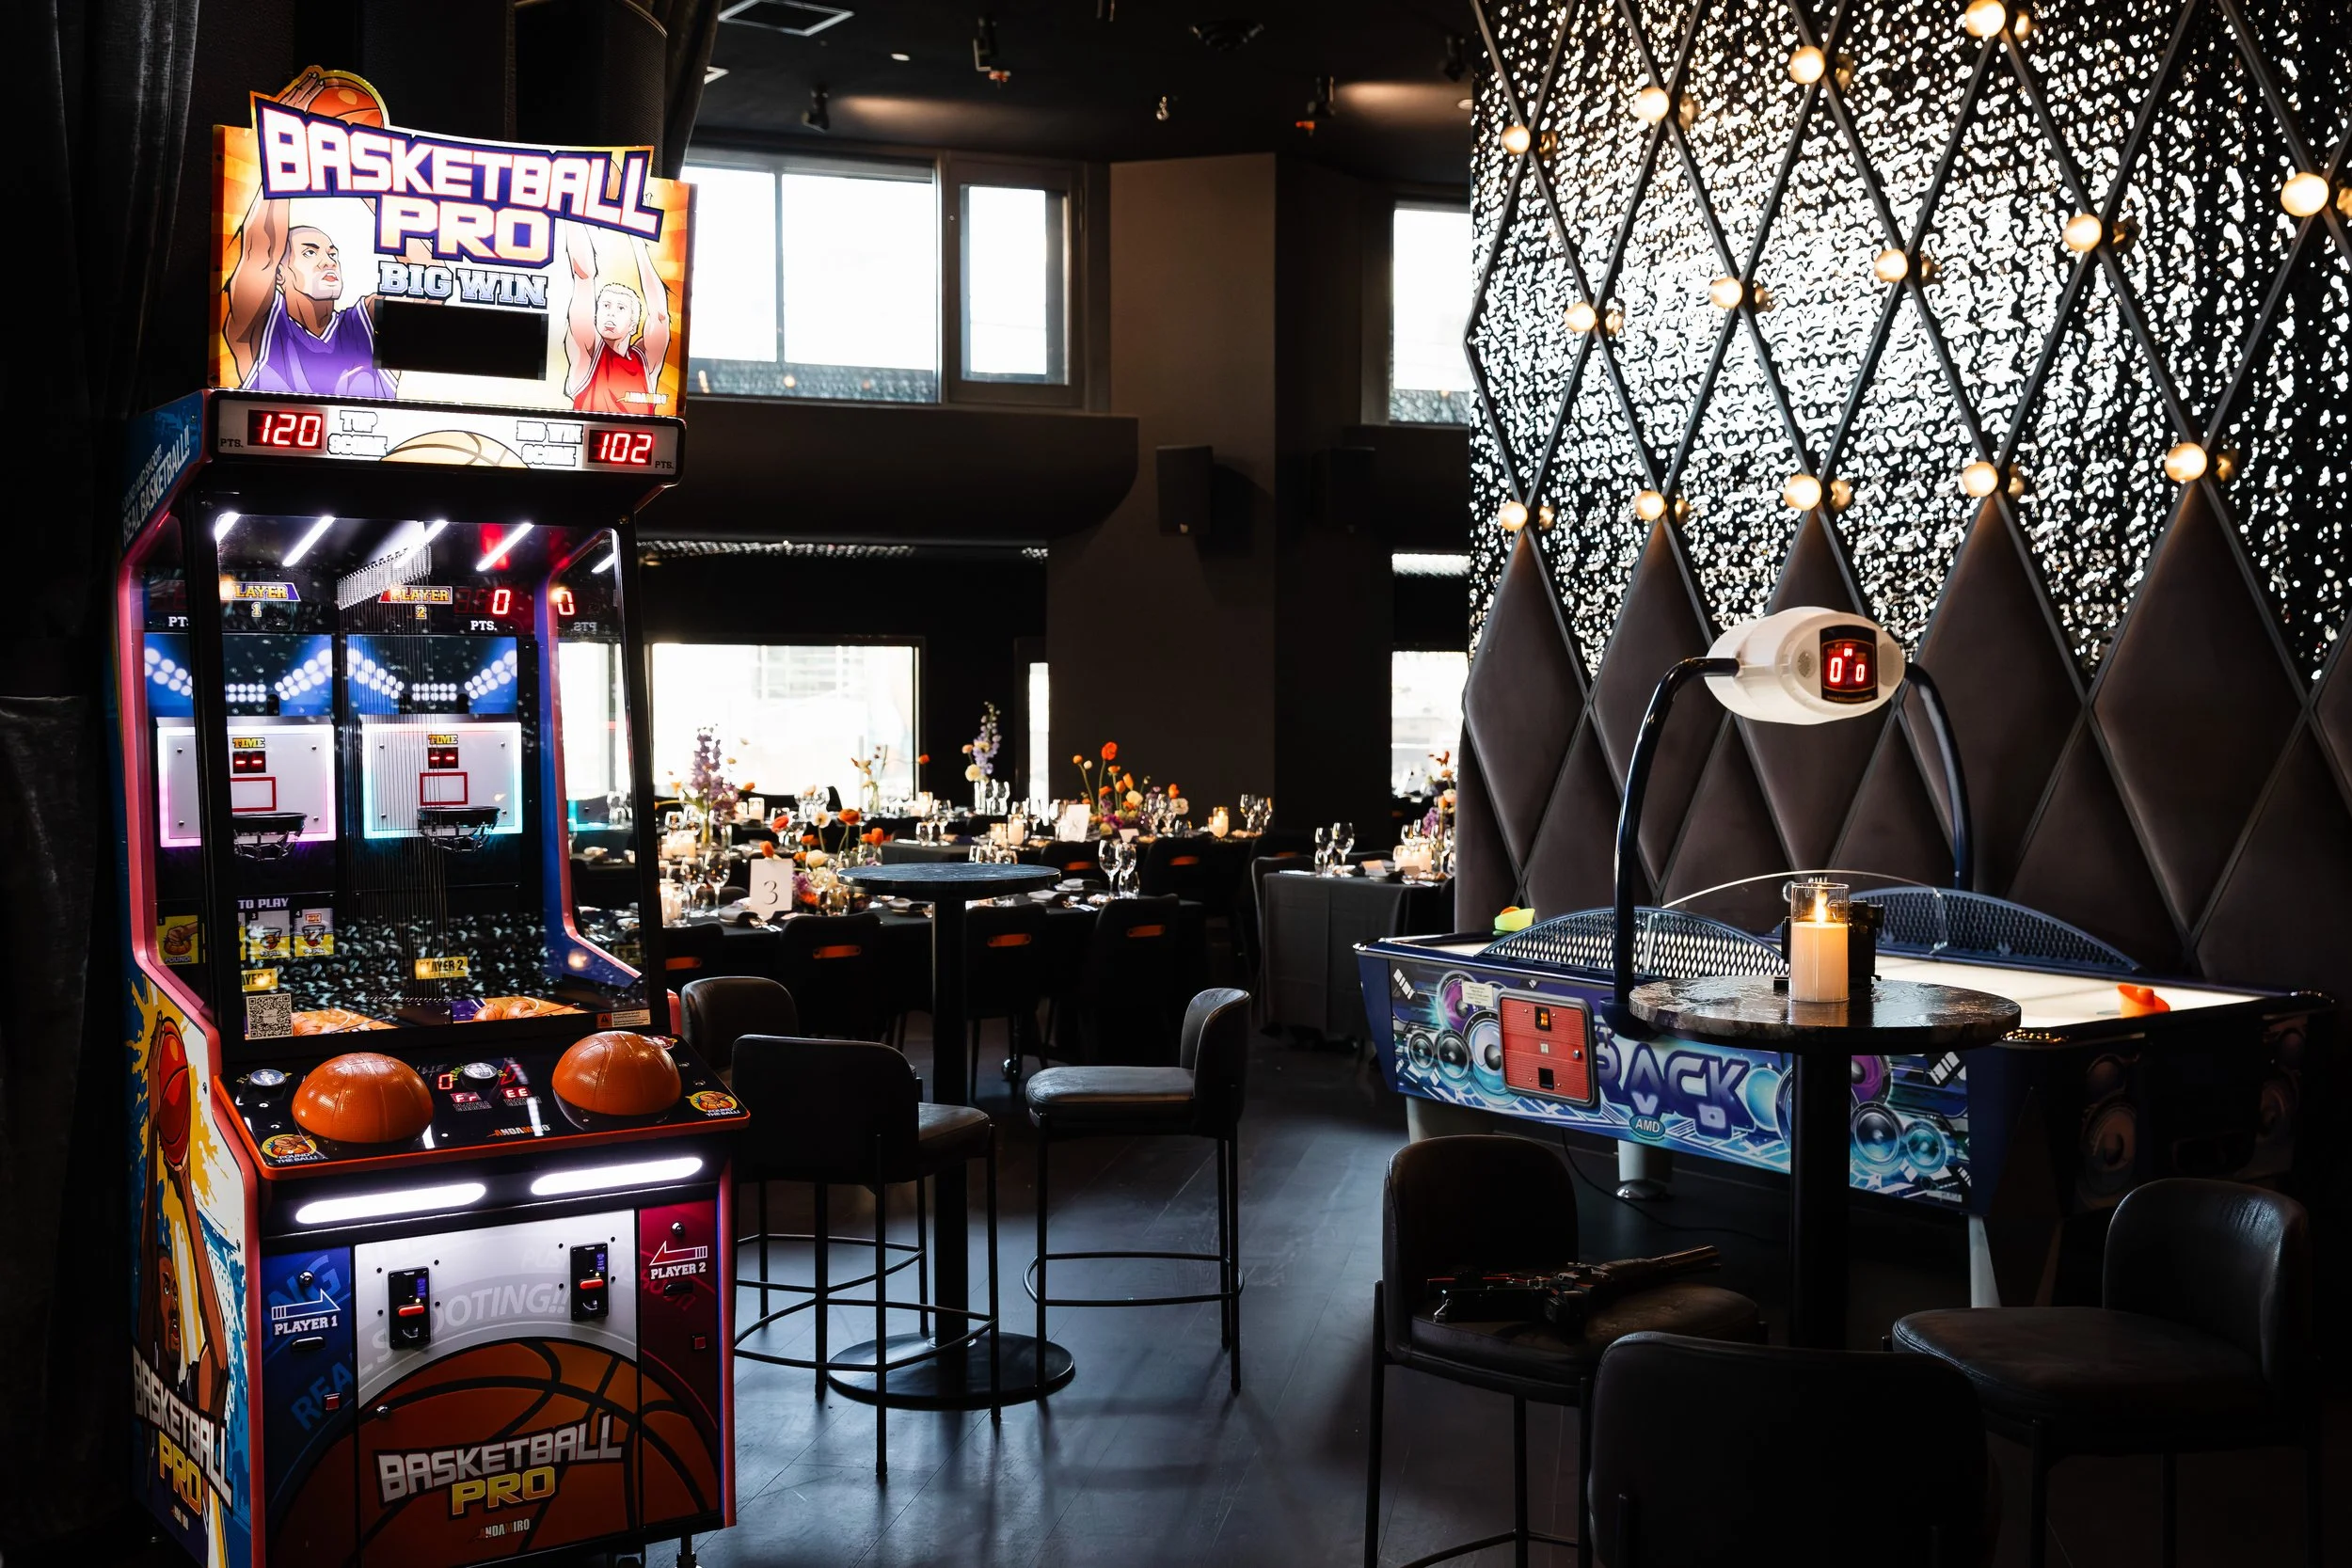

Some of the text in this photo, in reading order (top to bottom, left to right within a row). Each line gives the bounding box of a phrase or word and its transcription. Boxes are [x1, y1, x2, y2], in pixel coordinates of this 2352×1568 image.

[262, 107, 660, 235] BASKETBALL
[380, 196, 549, 263] PRO
[379, 261, 548, 308] BIG WIN
[262, 413, 322, 447] 120
[219, 437, 244, 449] PTS.
[600, 433, 653, 464] 102
[654, 460, 675, 469] PTS.
[122, 499, 141, 548] REAL
[229, 583, 289, 599] LAYER
[390, 585, 450, 603] PLAYER
[251, 602, 262, 617] 1
[416, 604, 426, 619] 2
[491, 589, 511, 615] 0
[168, 616, 188, 627] PT
[470, 620, 498, 631] PTS.
[232, 737, 265, 749] TIME
[428, 735, 458, 746] TIME
[763, 879, 779, 905] 3
[238, 897, 289, 910] TO PLAY
[456, 958, 464, 971] 2
[1635, 1118, 1661, 1133] AMD
[650, 1262, 696, 1280] PLAYER
[698, 1261, 707, 1274] 2
[273, 1315, 339, 1336] PLAYER 1
[133, 1345, 233, 1508] BASKETBALL
[377, 1414, 624, 1504] BASKETBALL
[158, 1433, 202, 1516] PRO
[452, 1465, 556, 1516] PRO
[478, 1517, 531, 1539] ANDAMIRO
